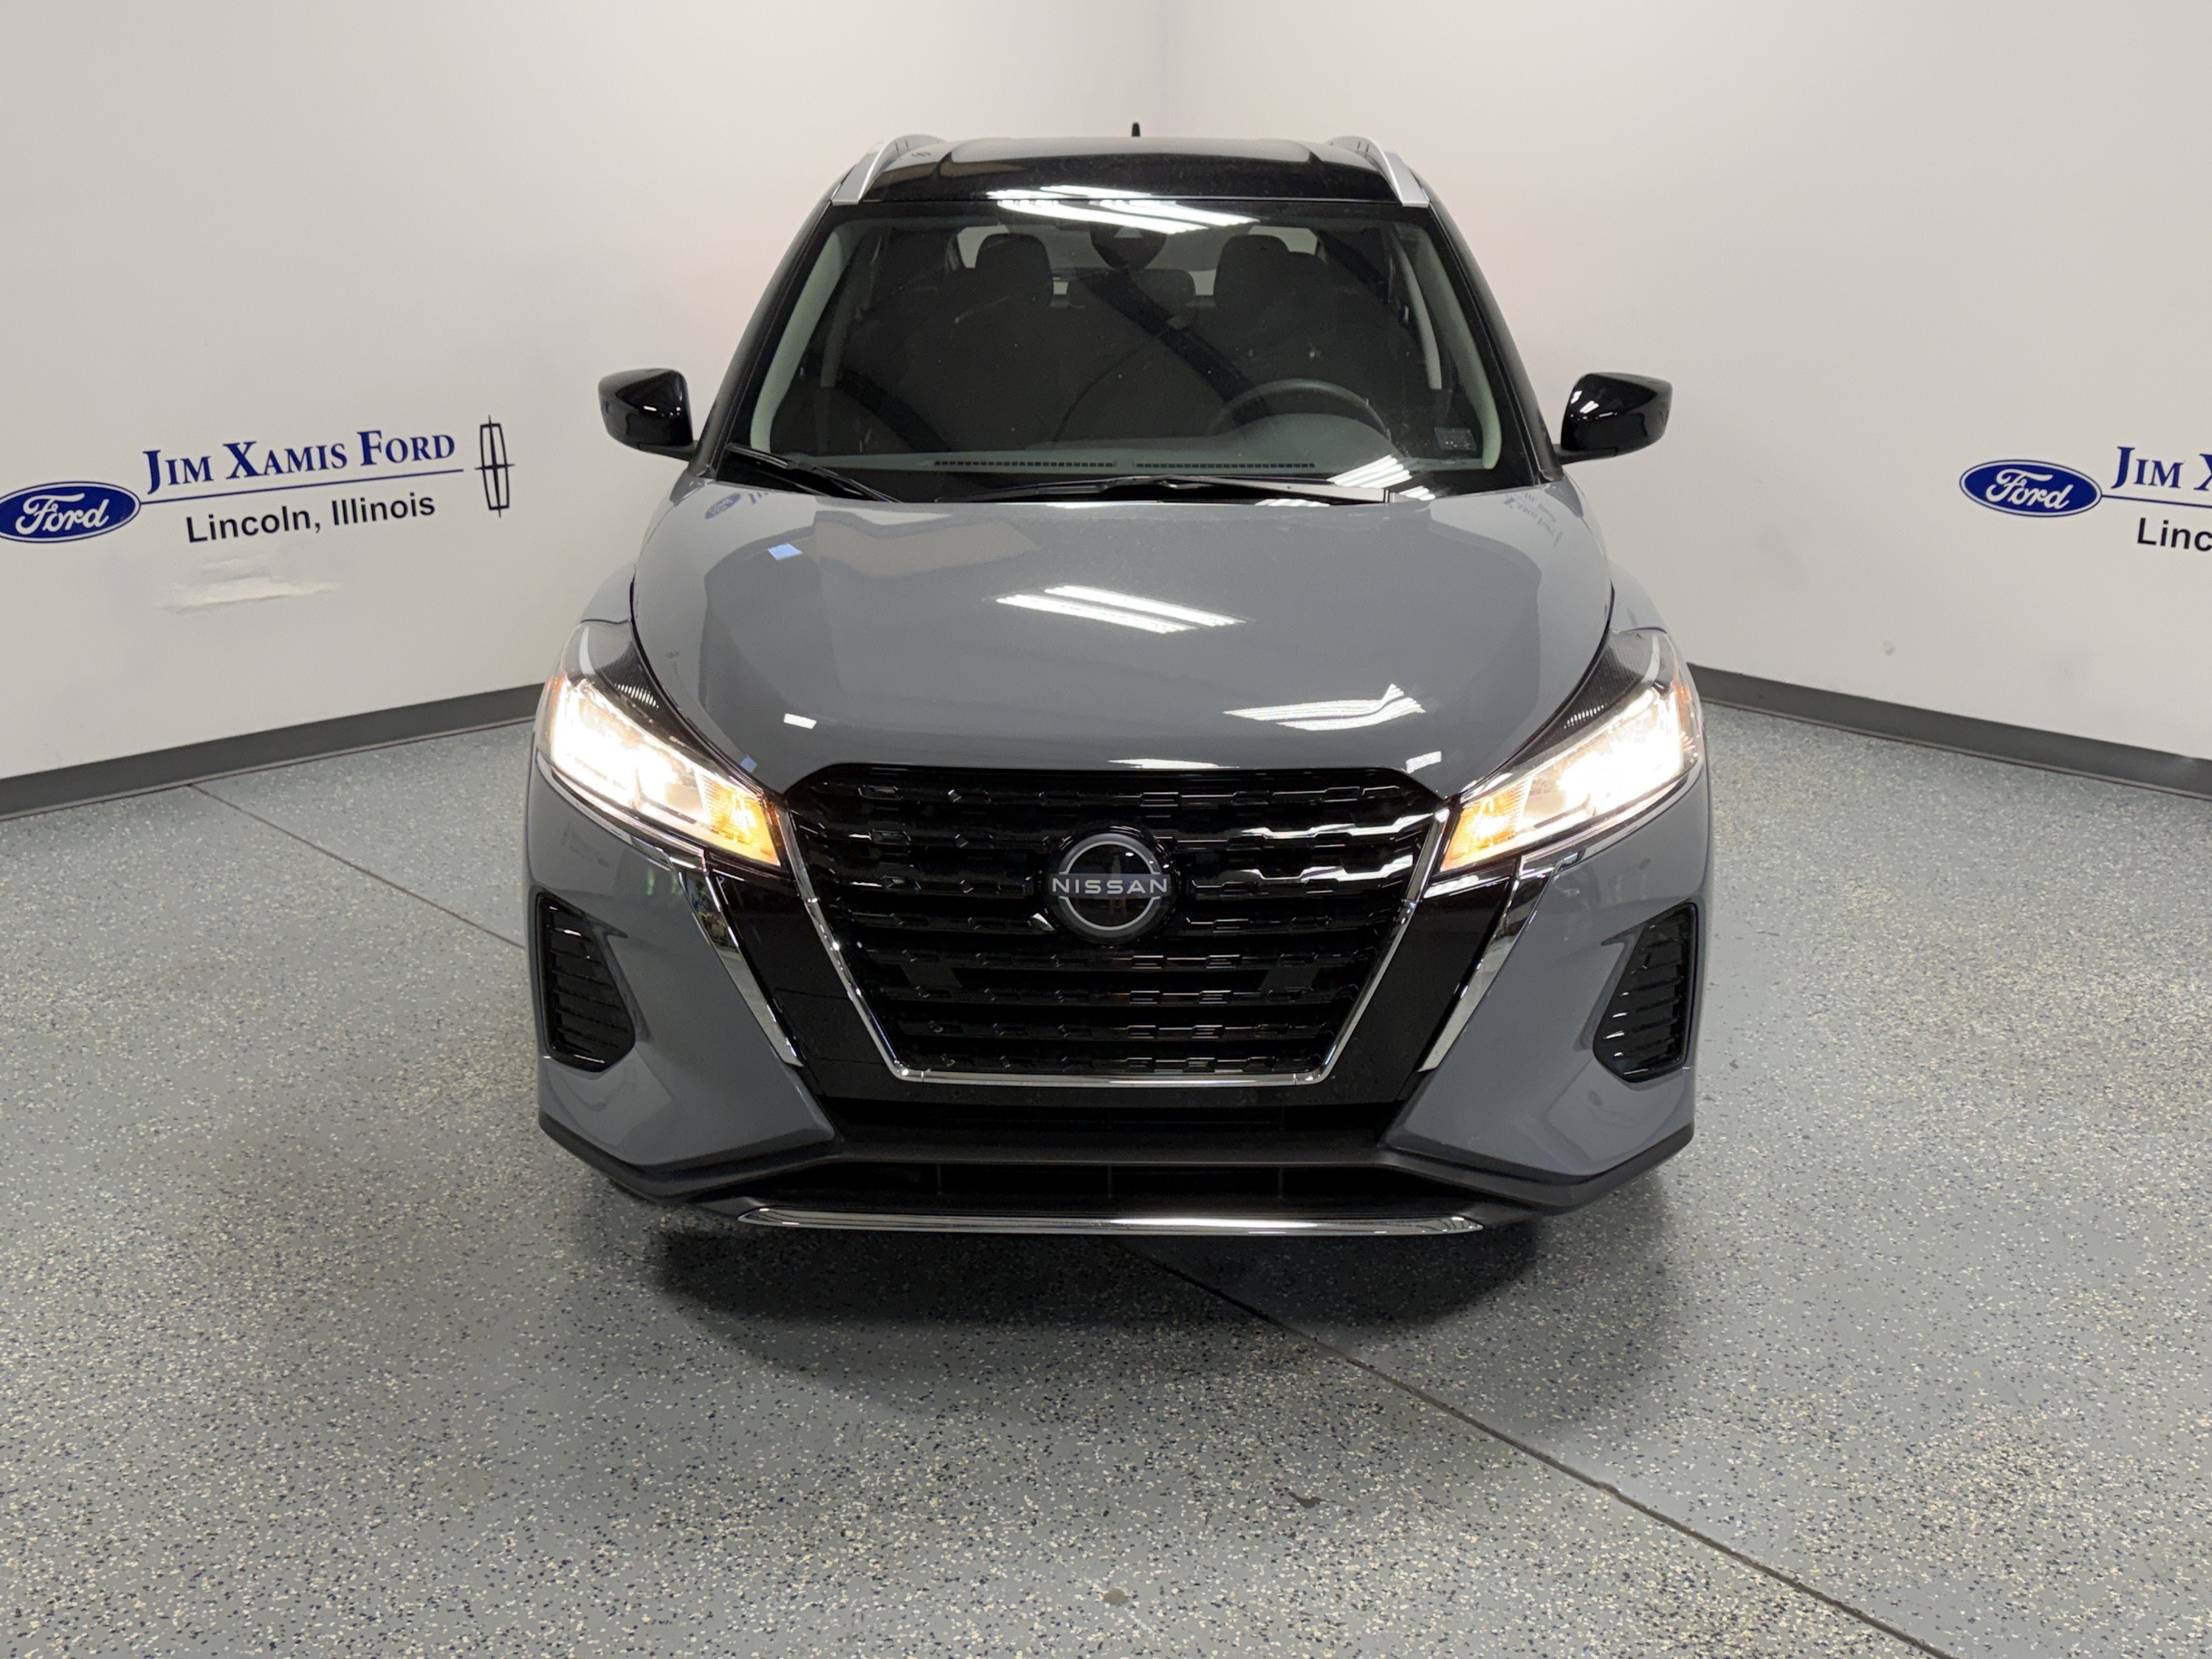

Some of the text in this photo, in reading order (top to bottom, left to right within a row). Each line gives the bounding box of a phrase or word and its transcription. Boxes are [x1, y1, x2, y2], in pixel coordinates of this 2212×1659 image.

[1985, 468, 2074, 510] Ford
[15, 493, 110, 535] Ford
[186, 492, 435, 543] Lincoln, Illinois
[1052, 878, 1167, 894] NISSAN
